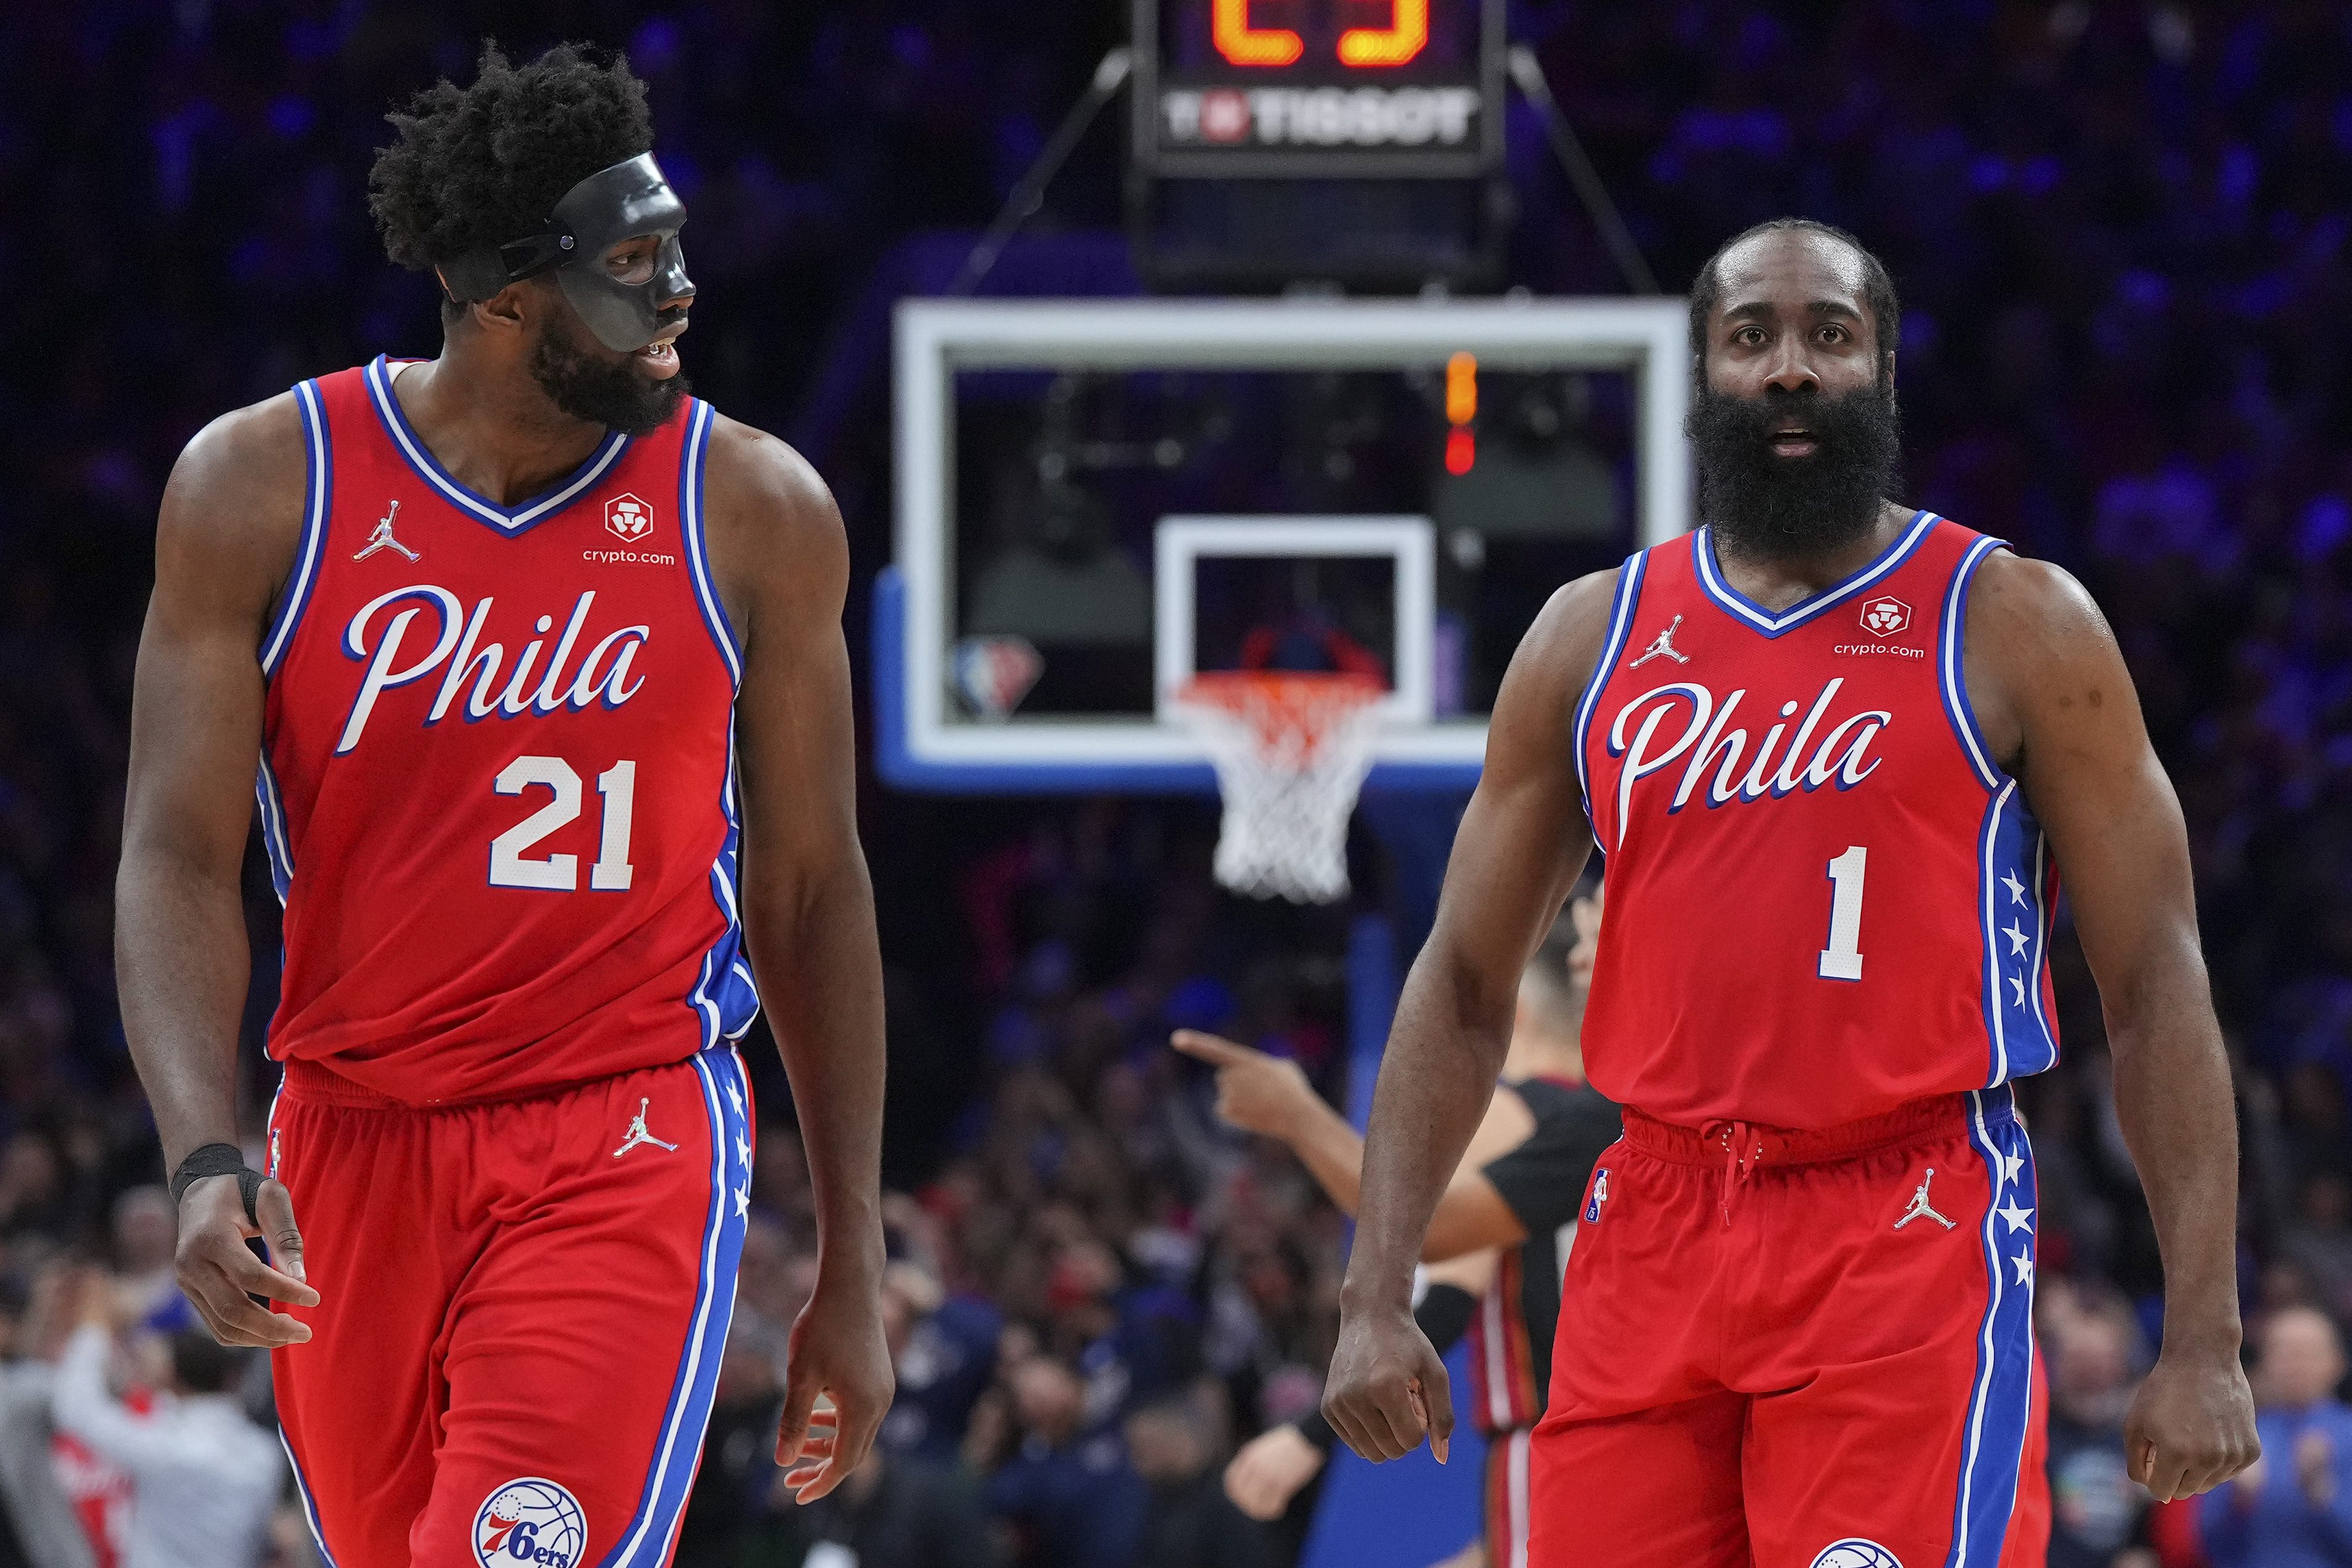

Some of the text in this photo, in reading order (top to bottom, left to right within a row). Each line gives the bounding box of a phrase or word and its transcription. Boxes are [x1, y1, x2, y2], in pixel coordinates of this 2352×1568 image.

[1252, 86, 1478, 146] TISSOT
[582, 550, 675, 566] crypto.com
[334, 584, 650, 757] Phila
[1834, 643, 1925, 658] crypto.com
[1607, 677, 1892, 851] Phila
[488, 755, 636, 891] 21
[1818, 845, 1868, 980] 1
[482, 1512, 569, 1568] 76ers
